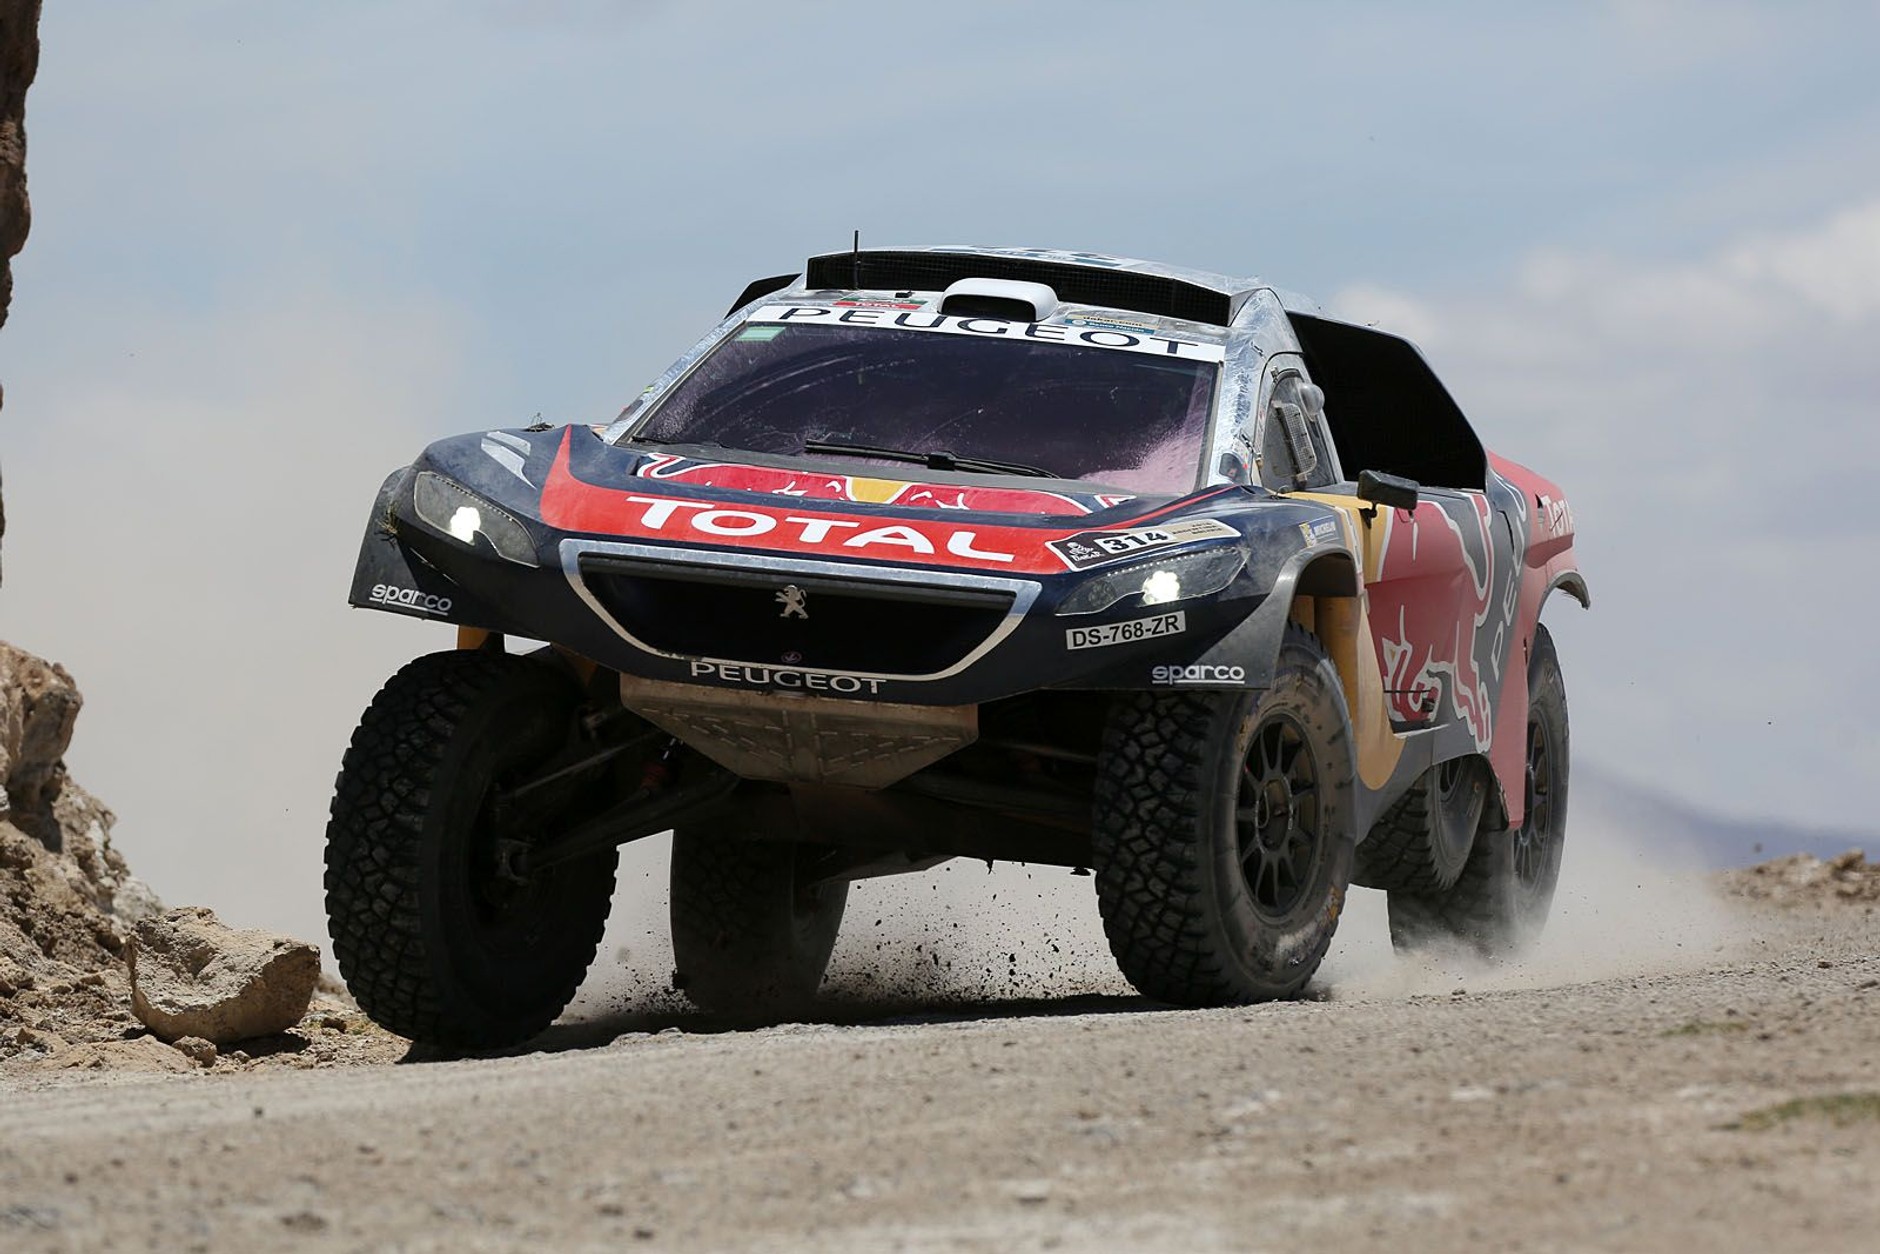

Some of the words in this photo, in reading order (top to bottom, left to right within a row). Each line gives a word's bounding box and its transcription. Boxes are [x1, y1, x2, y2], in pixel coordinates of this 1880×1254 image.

[779, 308, 1201, 354] PEUGEOT
[625, 496, 1015, 562] TOTAL
[1103, 531, 1168, 551] 314
[370, 584, 452, 613] sparco
[1072, 615, 1179, 648] DS-768-ZR
[691, 661, 886, 694] PEUGEOT
[1152, 665, 1245, 684] sparco
